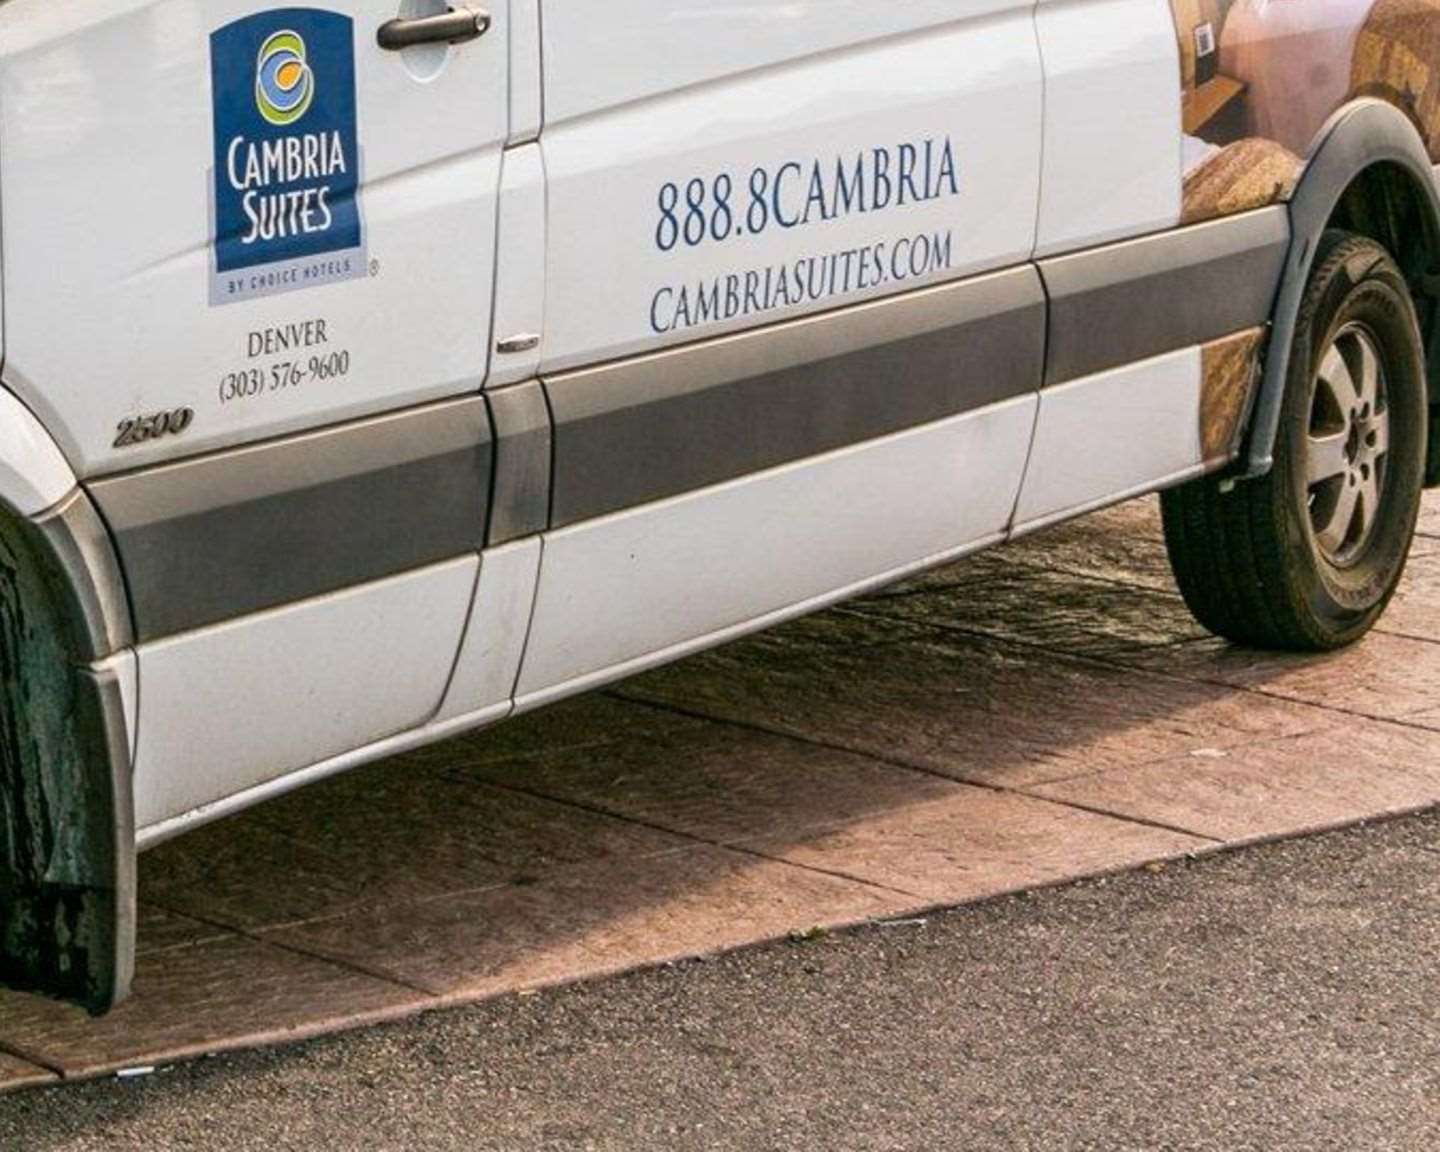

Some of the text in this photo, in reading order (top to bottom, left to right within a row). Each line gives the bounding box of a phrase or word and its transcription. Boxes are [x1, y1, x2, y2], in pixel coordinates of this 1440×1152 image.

[228, 131, 347, 192] CAMBRIA
[241, 187, 333, 244] SUITES
[655, 135, 959, 252] 888.8CAMBRIA
[228, 259, 351, 294] BY CHOICE HOTELS
[650, 231, 952, 333] CAMBRIASUITES.COM
[248, 319, 328, 358] DENVER
[218, 350, 350, 404] (303) 576-9600
[112, 407, 194, 449] 2500
